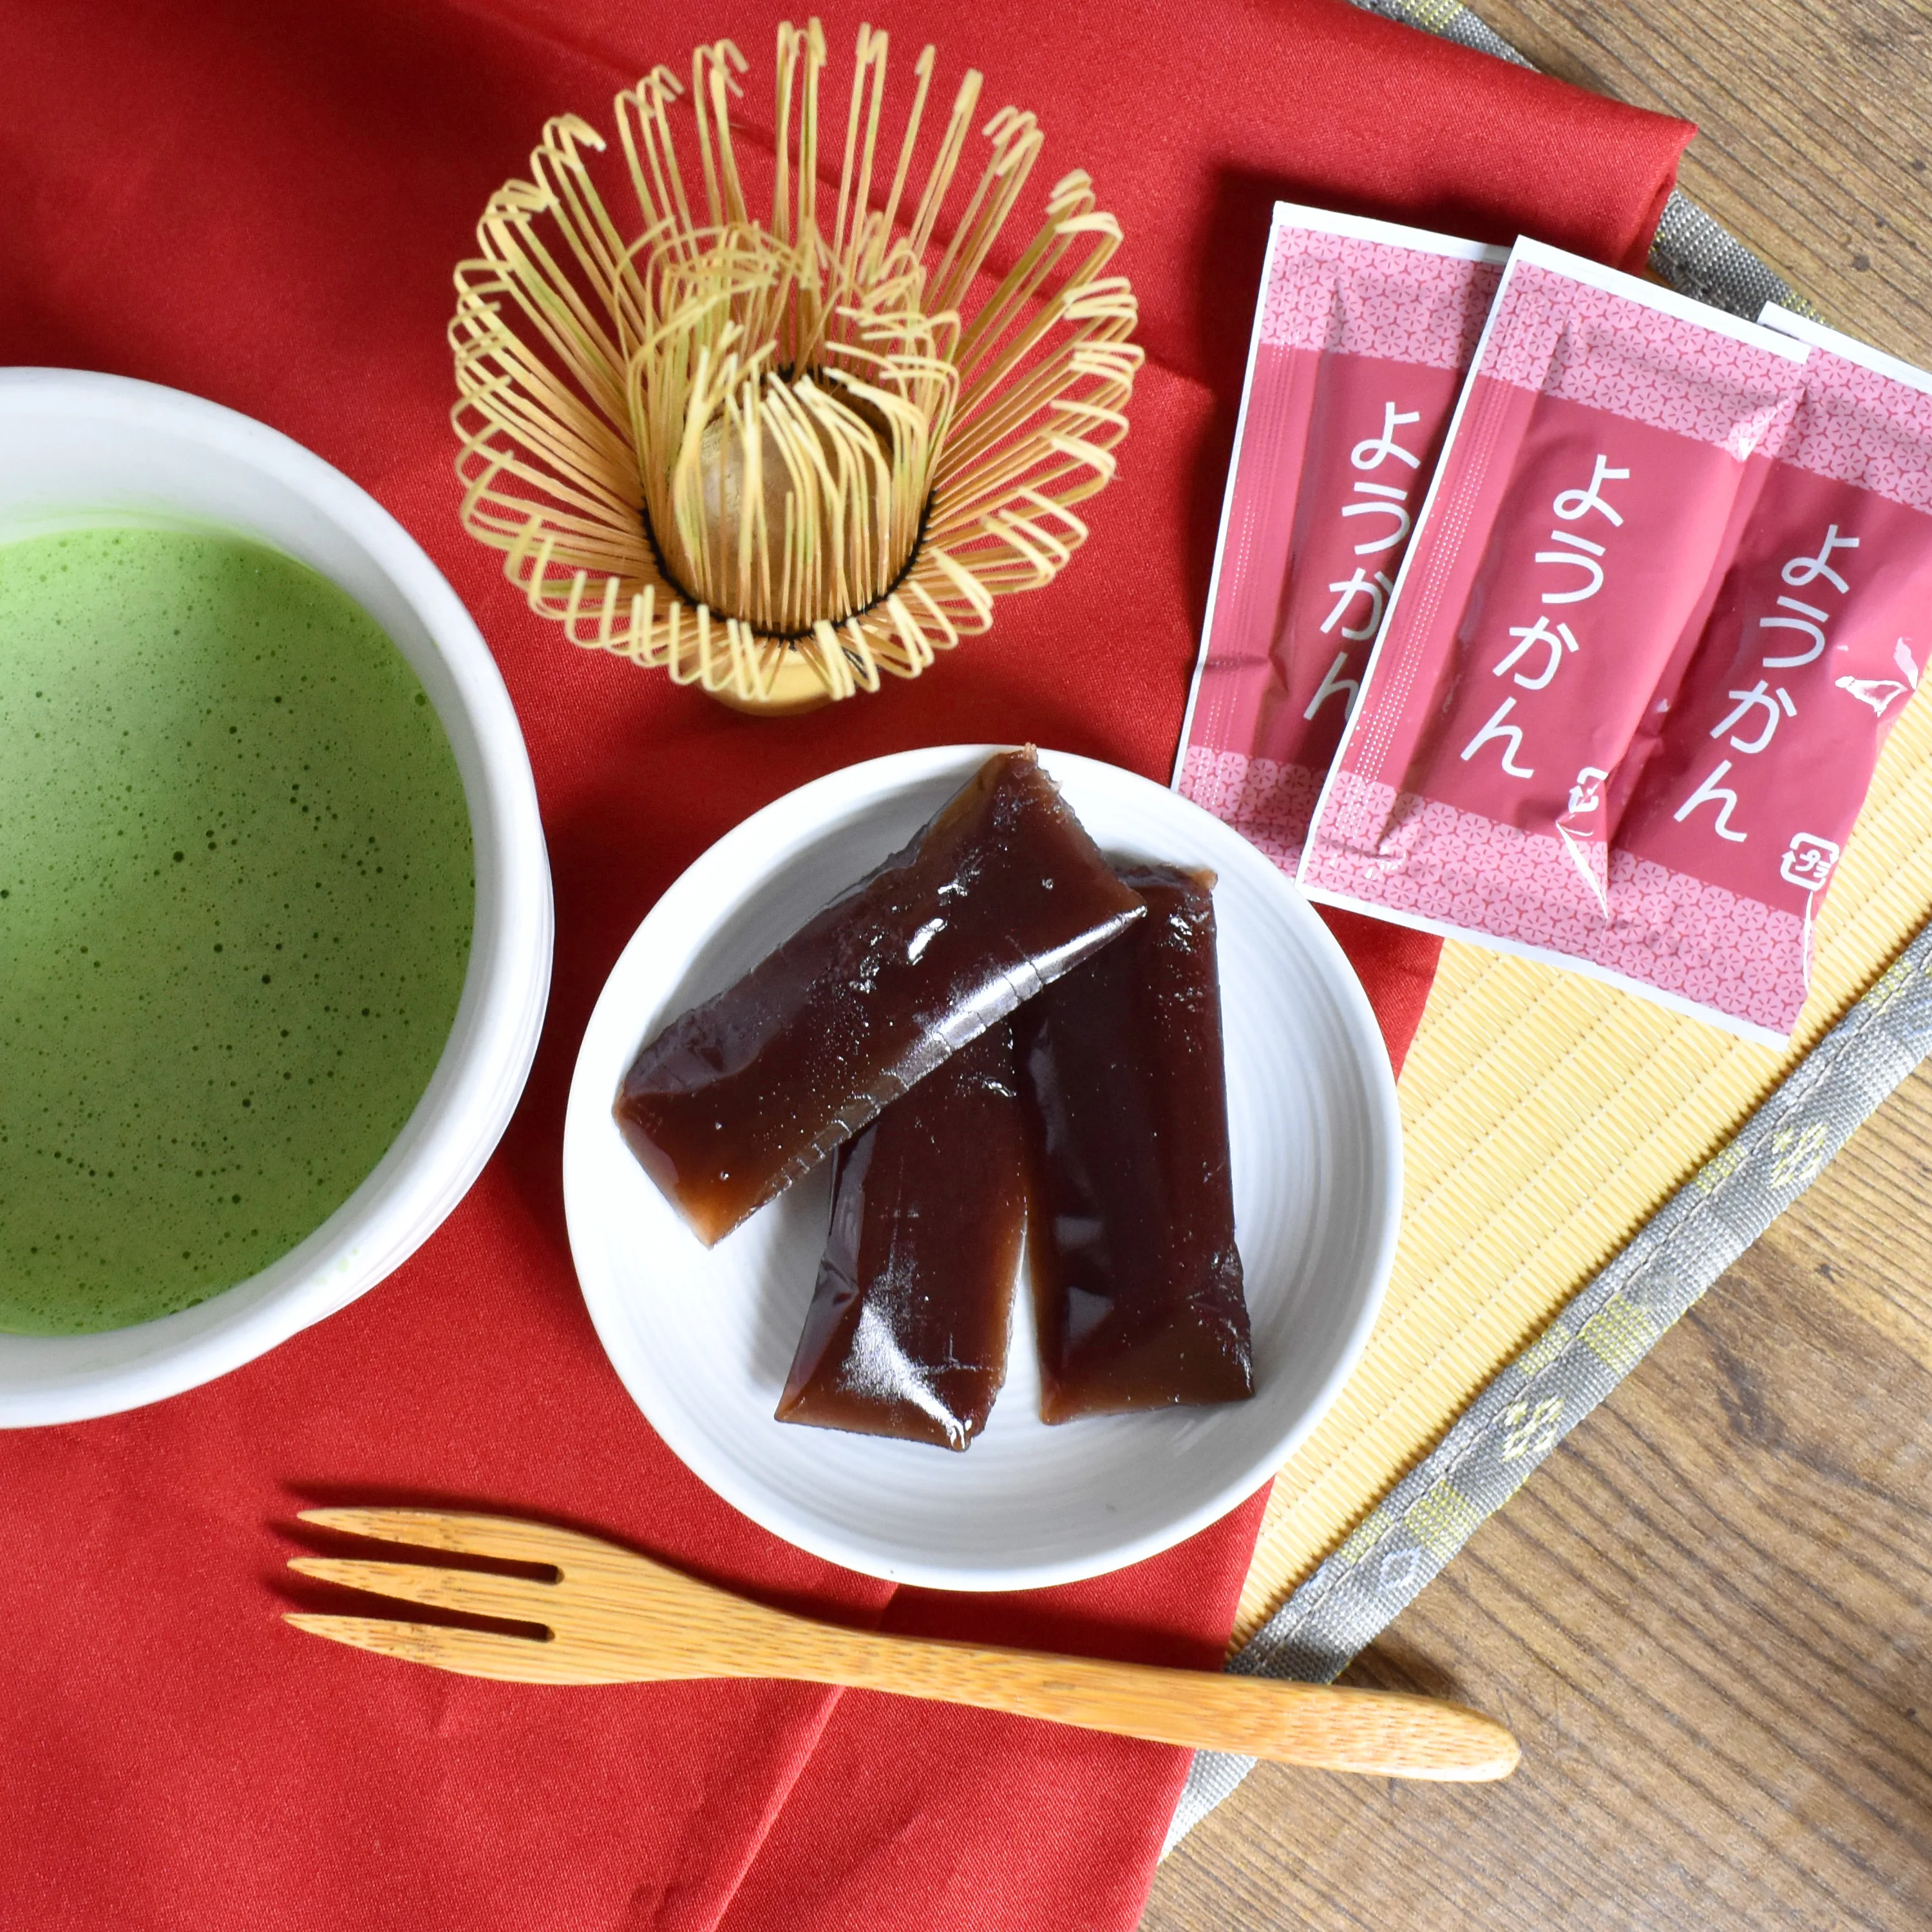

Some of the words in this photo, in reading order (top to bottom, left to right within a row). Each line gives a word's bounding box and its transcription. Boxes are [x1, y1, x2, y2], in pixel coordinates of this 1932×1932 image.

[1460, 454, 1631, 779] ようかん
[1673, 524, 1860, 843] ようかん
